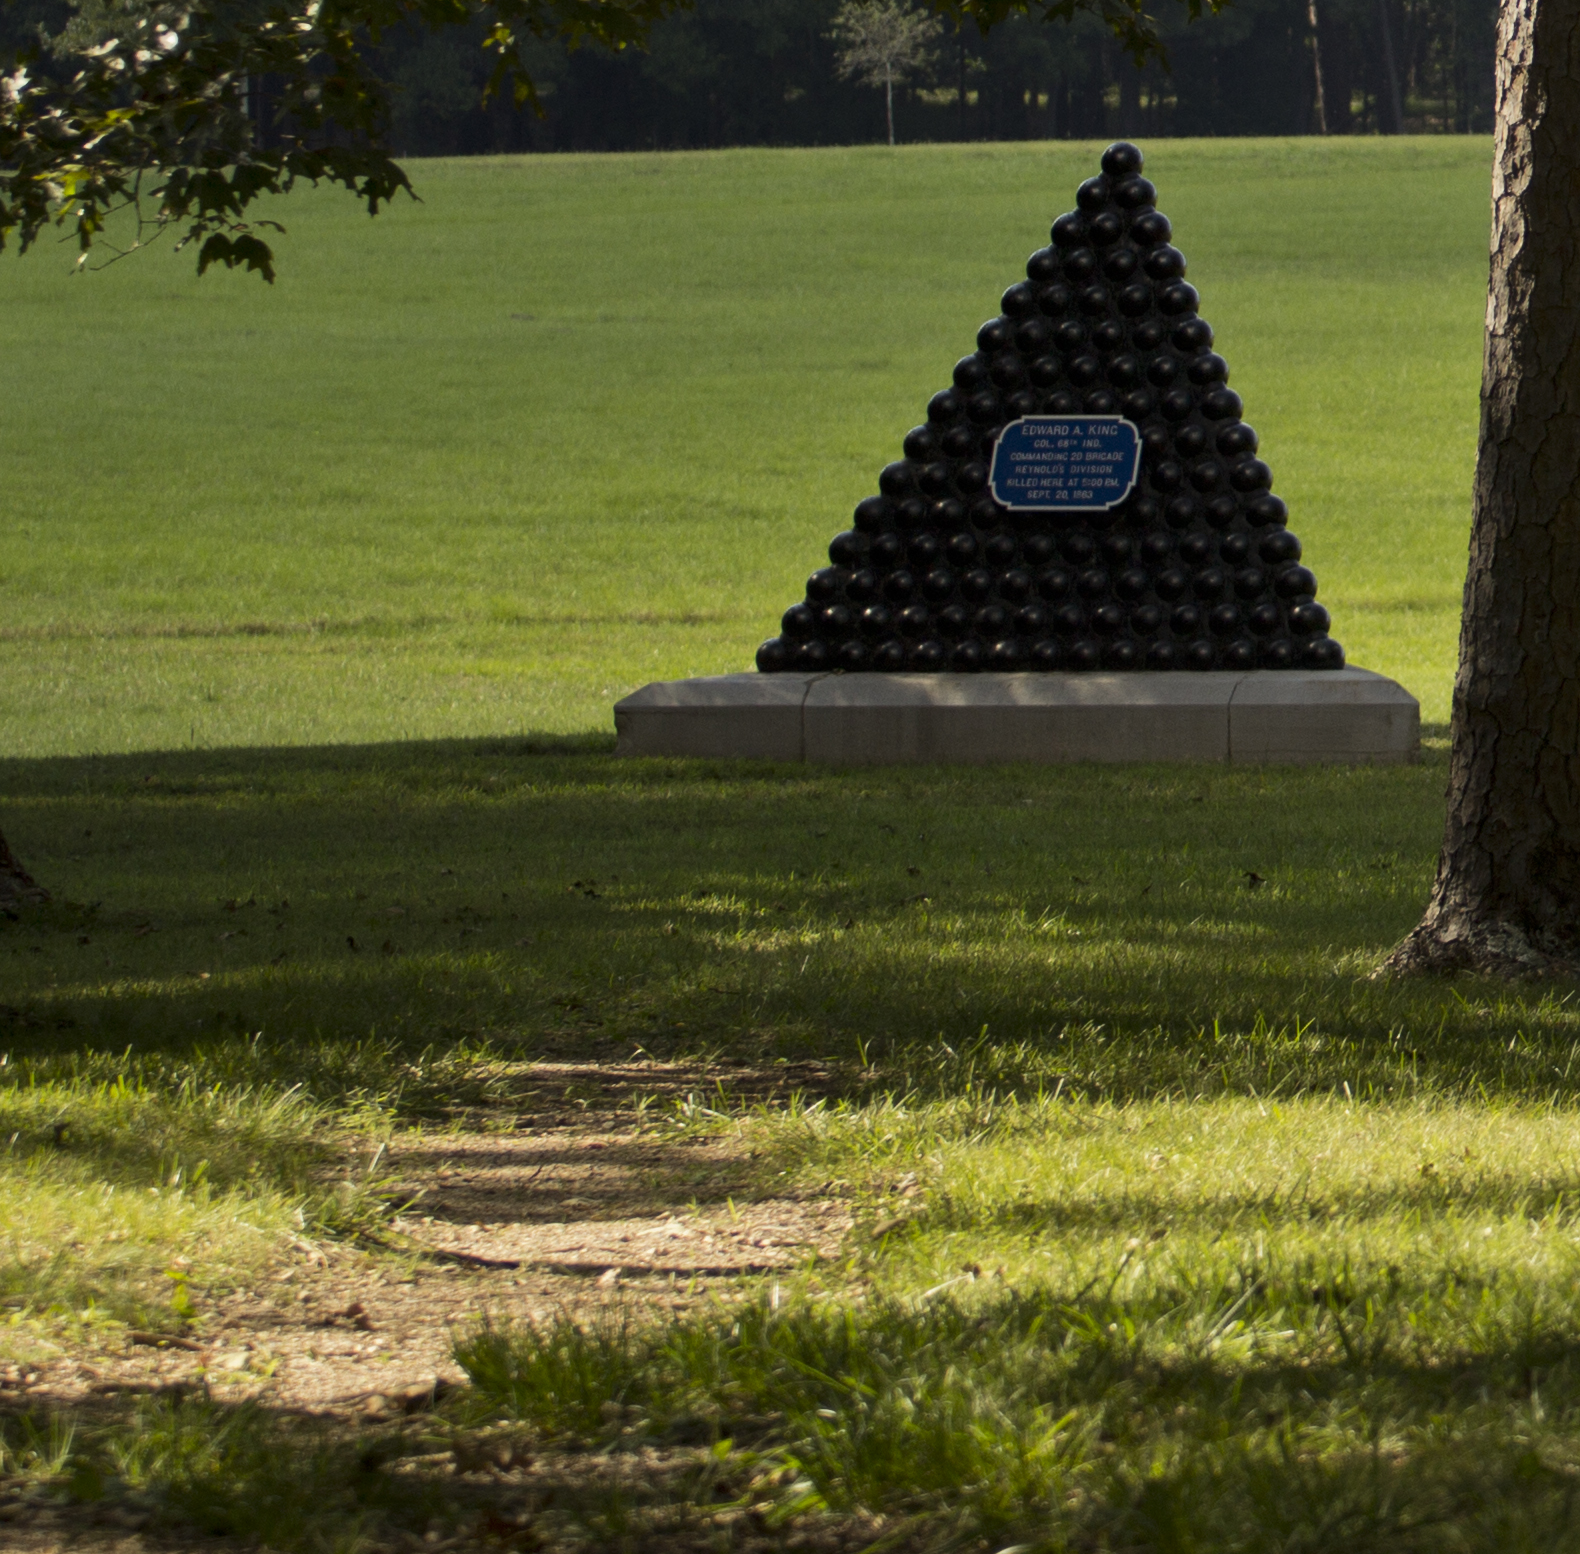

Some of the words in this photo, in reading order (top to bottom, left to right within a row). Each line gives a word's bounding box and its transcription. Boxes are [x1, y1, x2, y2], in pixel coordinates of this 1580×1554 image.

[1022, 425, 1069, 436] EDWARD
[1072, 426, 1083, 436] A.
[1088, 425, 1118, 436] KING
[1034, 440, 1054, 448] COL.
[1083, 440, 1101, 448] IND.
[1010, 452, 1068, 461] COMMANDING
[1070, 453, 1082, 461] 2D
[1085, 452, 1124, 461] BRIGADE
[1070, 465, 1113, 473] DIVISION
[1007, 478, 1038, 486] KILLED
[1040, 478, 1063, 487] HERE
[1068, 478, 1078, 486] AT
[1074, 490, 1093, 499] 1863
